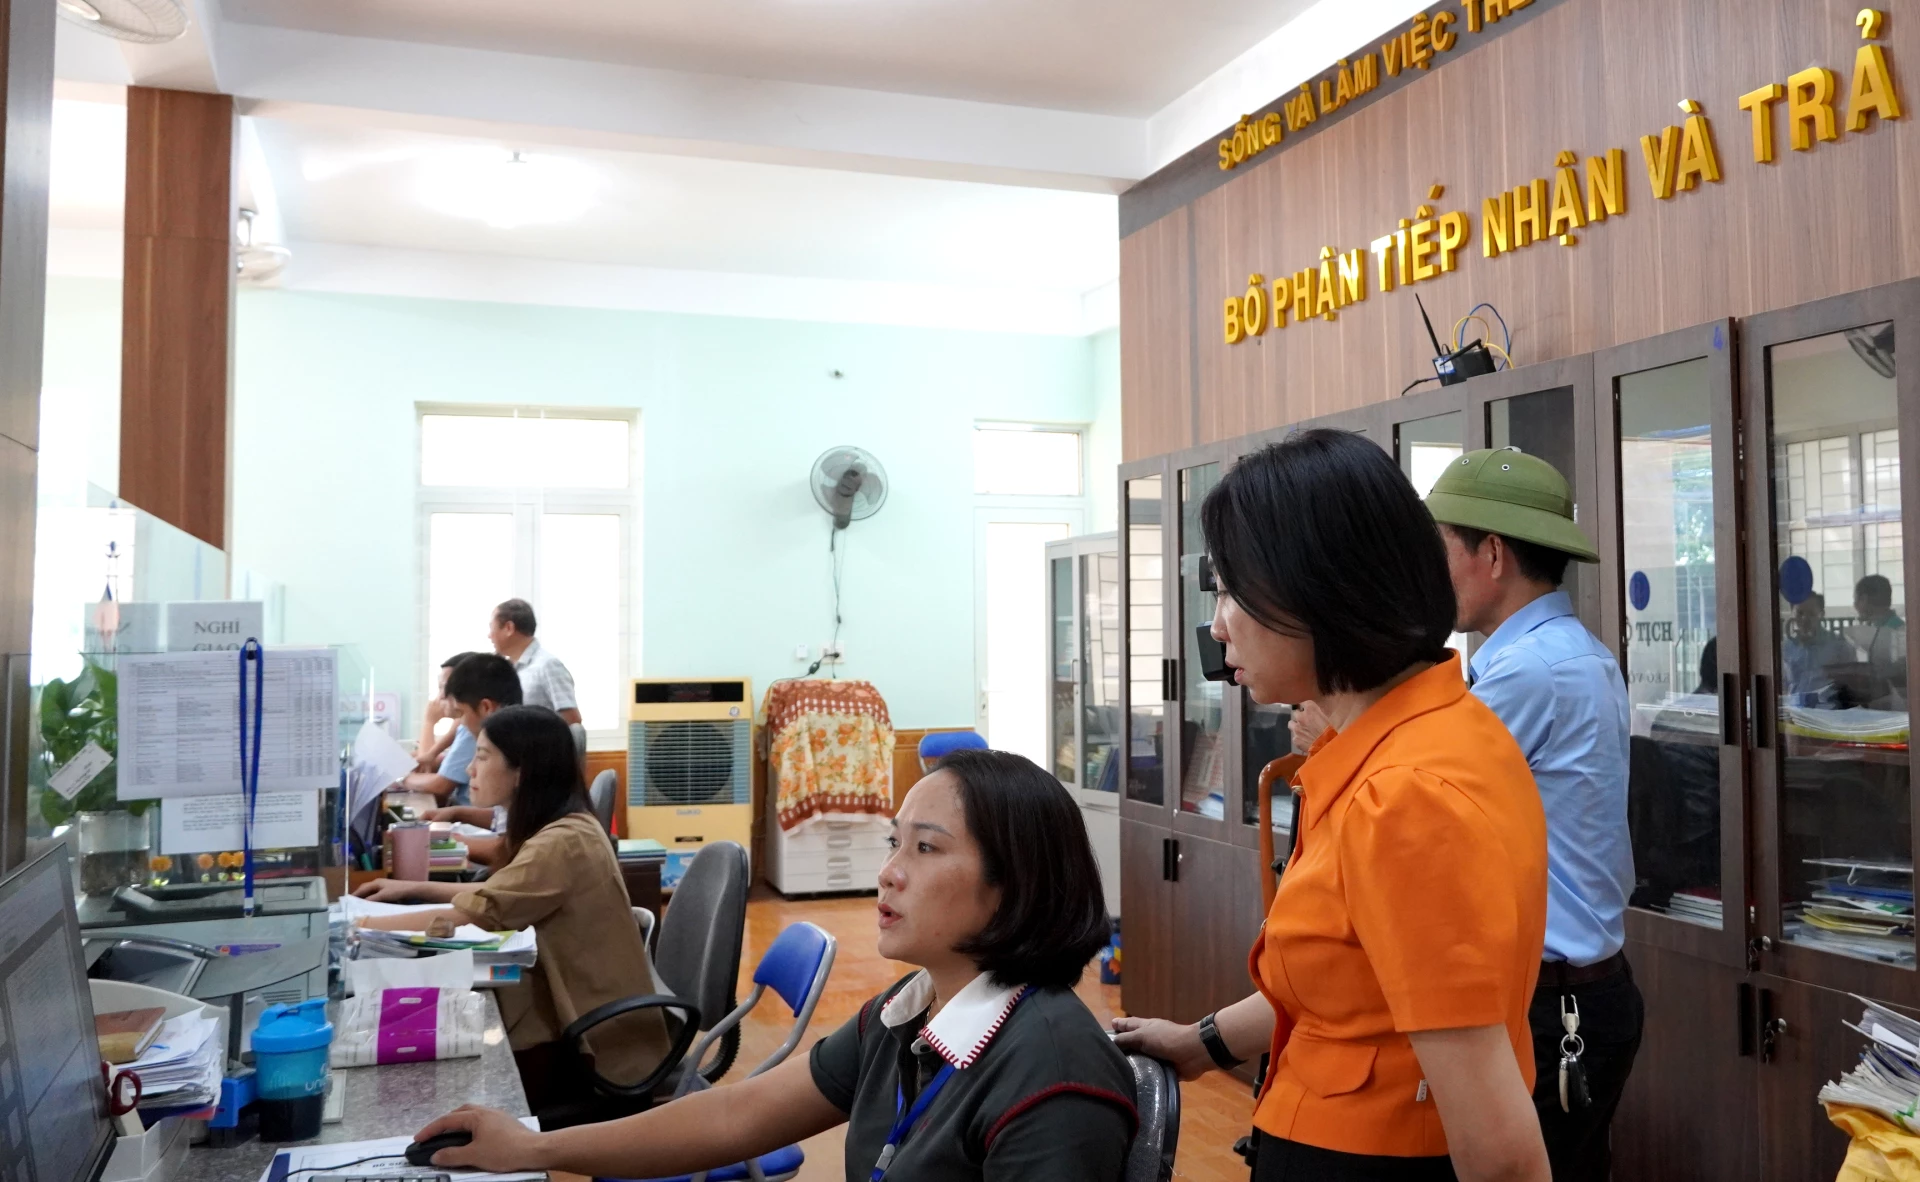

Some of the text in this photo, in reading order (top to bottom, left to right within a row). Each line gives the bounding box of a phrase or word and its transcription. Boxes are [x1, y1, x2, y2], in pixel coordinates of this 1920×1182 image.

[1218, 0, 1534, 170] SỐNG VÀ LÀM VIỆC TH
[1273, 246, 1365, 328] PHẬN
[1482, 149, 1624, 257] NHẬN
[1640, 98, 1720, 199] VÀ
[1739, 8, 1900, 164] TRẢ
